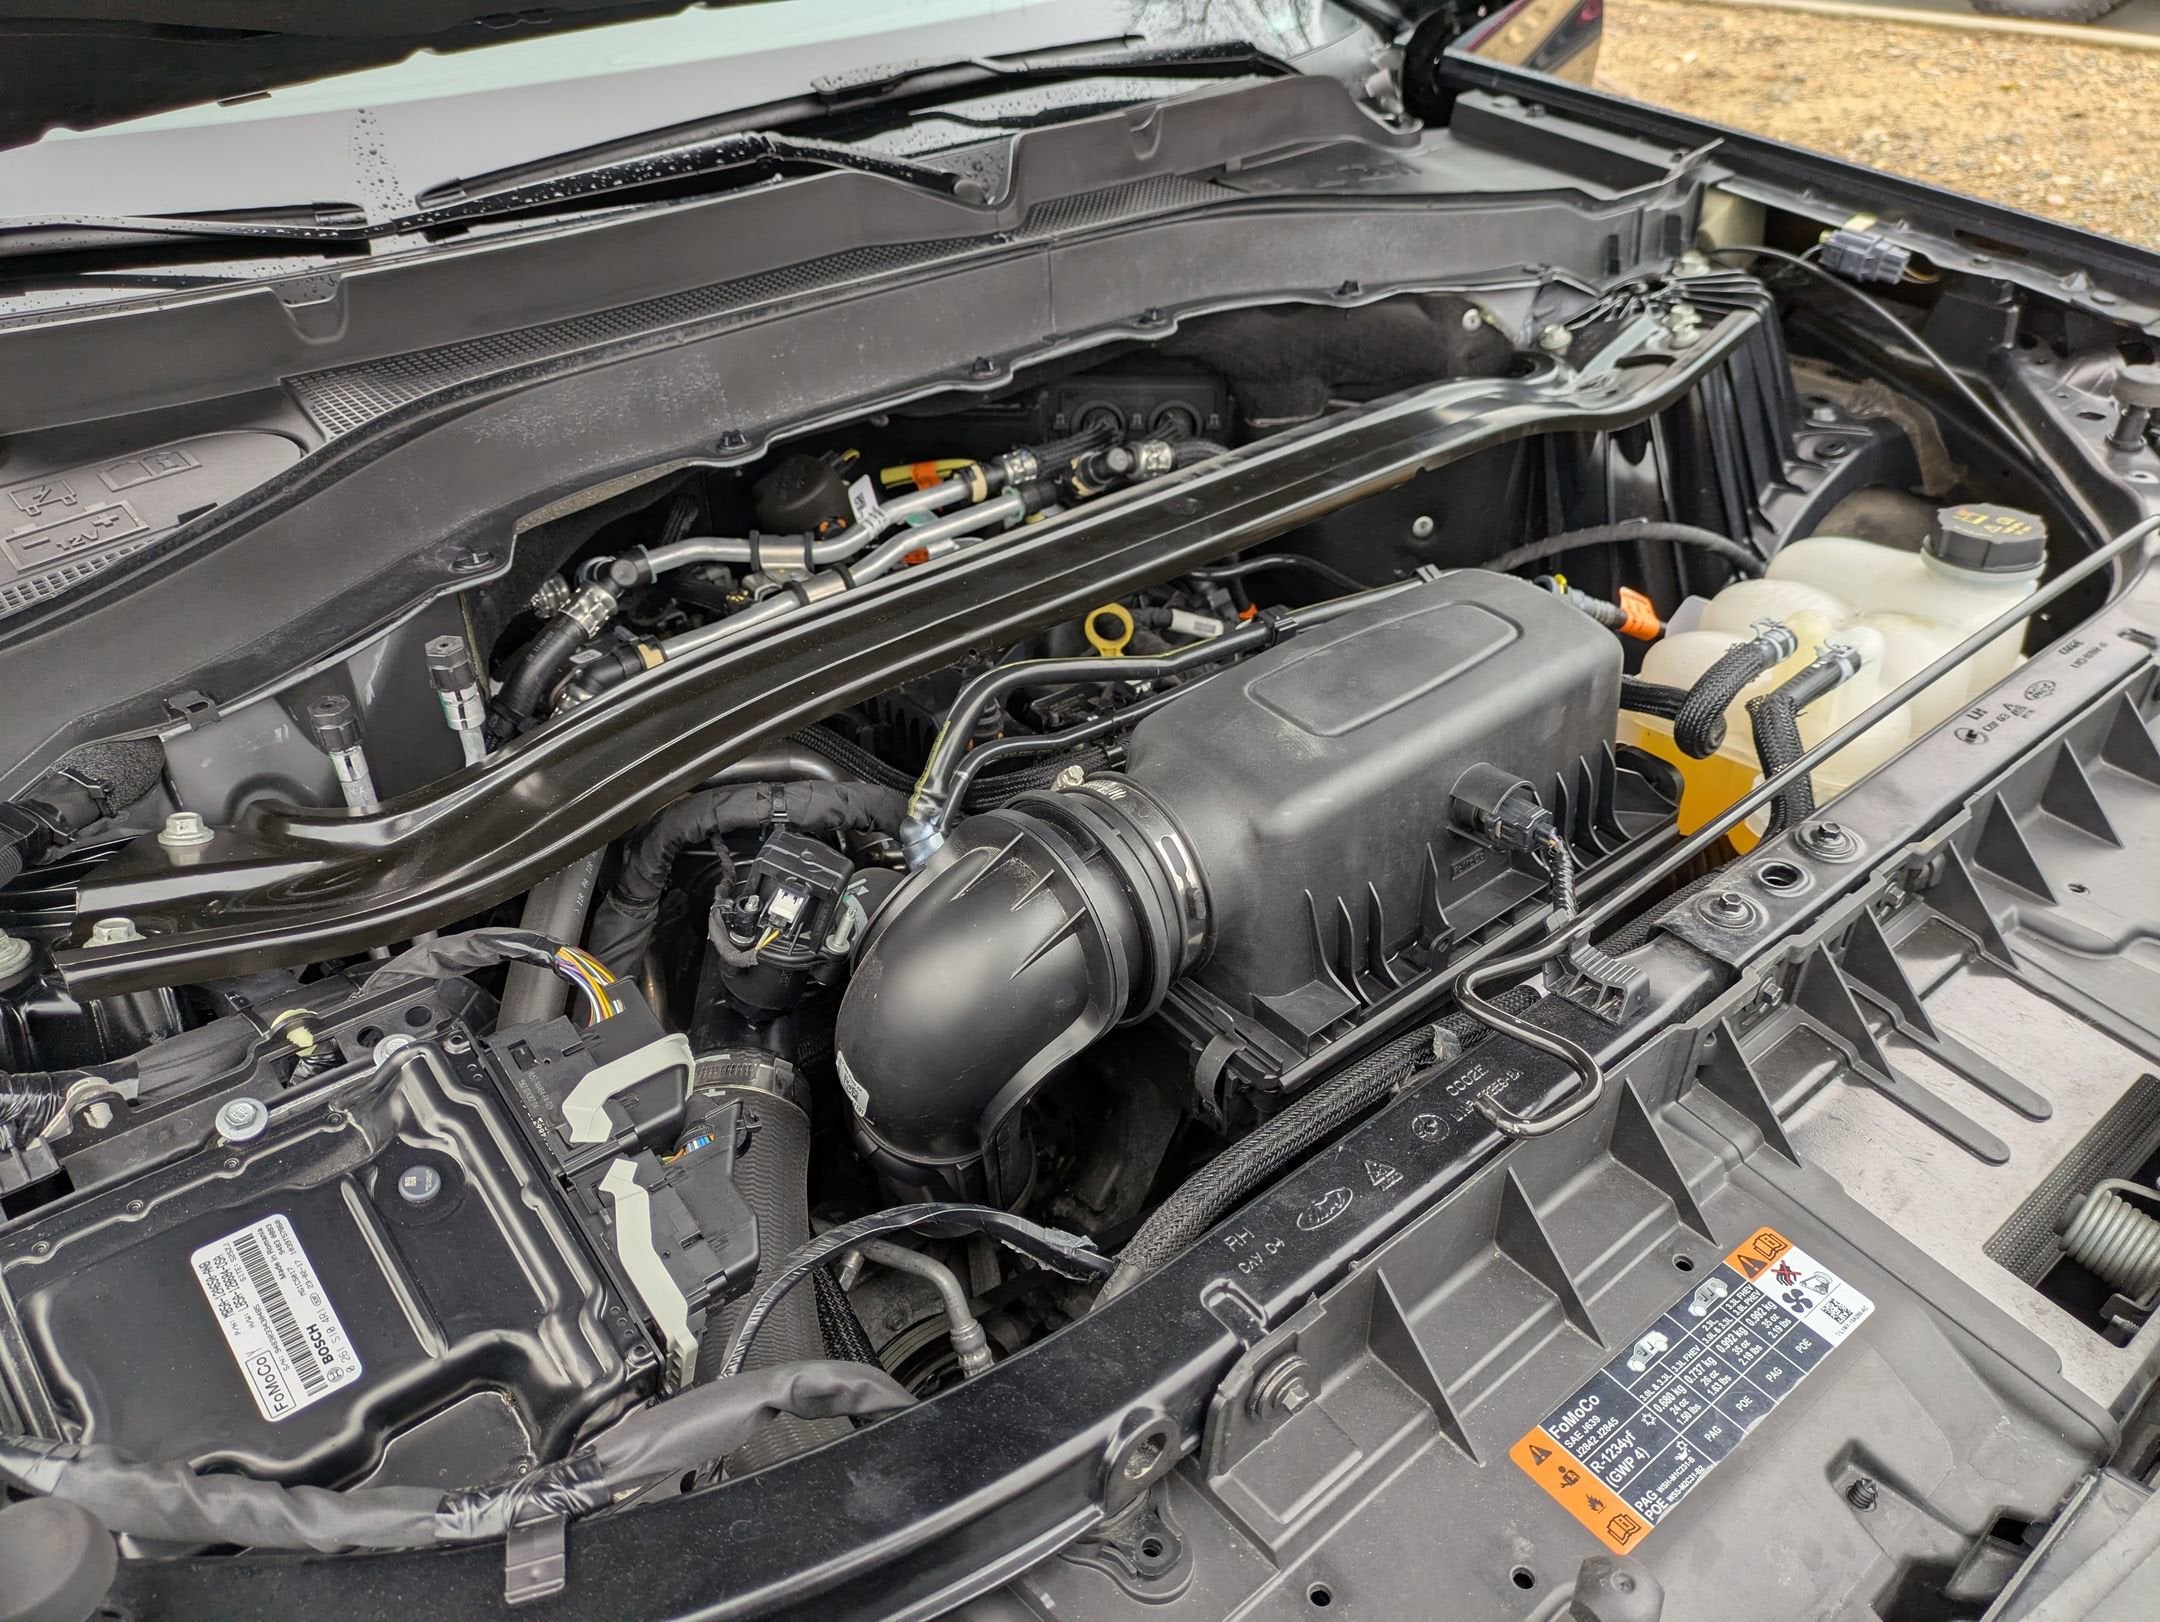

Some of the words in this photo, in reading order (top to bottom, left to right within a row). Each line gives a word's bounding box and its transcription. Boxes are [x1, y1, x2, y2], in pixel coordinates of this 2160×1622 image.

[56, 526, 98, 551] 12V
[257, 1227, 274, 1255] Romania
[1224, 1226, 1255, 1252] RH
[271, 1254, 278, 1262] in
[233, 1263, 247, 1282] SITE:
[274, 1262, 286, 1280] Made
[294, 1260, 314, 1289] 23-02-17
[1725, 1298, 1741, 1310] 3.3L
[1736, 1284, 1753, 1300] FHEV
[1743, 1289, 1761, 1306] PHEV
[1718, 1317, 1733, 1329] 3.3L
[1745, 1307, 1767, 1326] 0.992
[1761, 1301, 1777, 1311] kg
[1761, 1318, 1773, 1329] 35
[1770, 1313, 1780, 1322] oz
[230, 1320, 241, 1336] P/N:
[1767, 1325, 1783, 1339] 2.19
[1778, 1318, 1792, 1328] lbs
[306, 1323, 334, 1365] BOSCH
[1715, 1333, 1738, 1353] 0.992
[1732, 1326, 1749, 1338] kg
[1732, 1345, 1743, 1355] 35
[1740, 1339, 1751, 1349] oz
[1795, 1338, 1812, 1354] POE
[278, 1355, 290, 1371] S/N:
[336, 1347, 350, 1363] 261
[1671, 1360, 1687, 1372] 3.3L
[1683, 1344, 1701, 1362] FHEV
[1738, 1351, 1754, 1366] 2.19
[1749, 1344, 1763, 1355] lbs
[1684, 1363, 1706, 1384] 0.737
[1701, 1356, 1717, 1368] kg
[1700, 1375, 1712, 1387] 26
[1709, 1370, 1720, 1379] oz
[1765, 1367, 1783, 1382] PAG
[256, 1356, 289, 1413] FoMoCo
[1639, 1389, 1655, 1402] 3.0L
[1651, 1383, 1660, 1391] &
[1656, 1373, 1673, 1386] 3.3L
[1707, 1382, 1723, 1396] 1.63
[1718, 1375, 1732, 1386] lbs
[1653, 1392, 1676, 1413] 0.680
[1670, 1384, 1687, 1396] kg
[1669, 1404, 1682, 1416] 24
[1679, 1398, 1690, 1408] oz
[1735, 1395, 1753, 1412] POE
[1548, 1395, 1600, 1439] FoMoCo
[1676, 1410, 1692, 1425] 1.50
[1687, 1404, 1702, 1415] lbs
[1564, 1430, 1584, 1448] SAE
[1582, 1415, 1601, 1434] J639
[1576, 1435, 1599, 1458] J2842
[1596, 1417, 1619, 1439] J2845
[1704, 1425, 1722, 1442] PAG
[1589, 1429, 1636, 1474] R-1234yf
[1605, 1456, 1635, 1488] (GWP
[1634, 1446, 1650, 1460] 4)
[1634, 1490, 1658, 1512] PAG
[1644, 1497, 1669, 1521] POE
